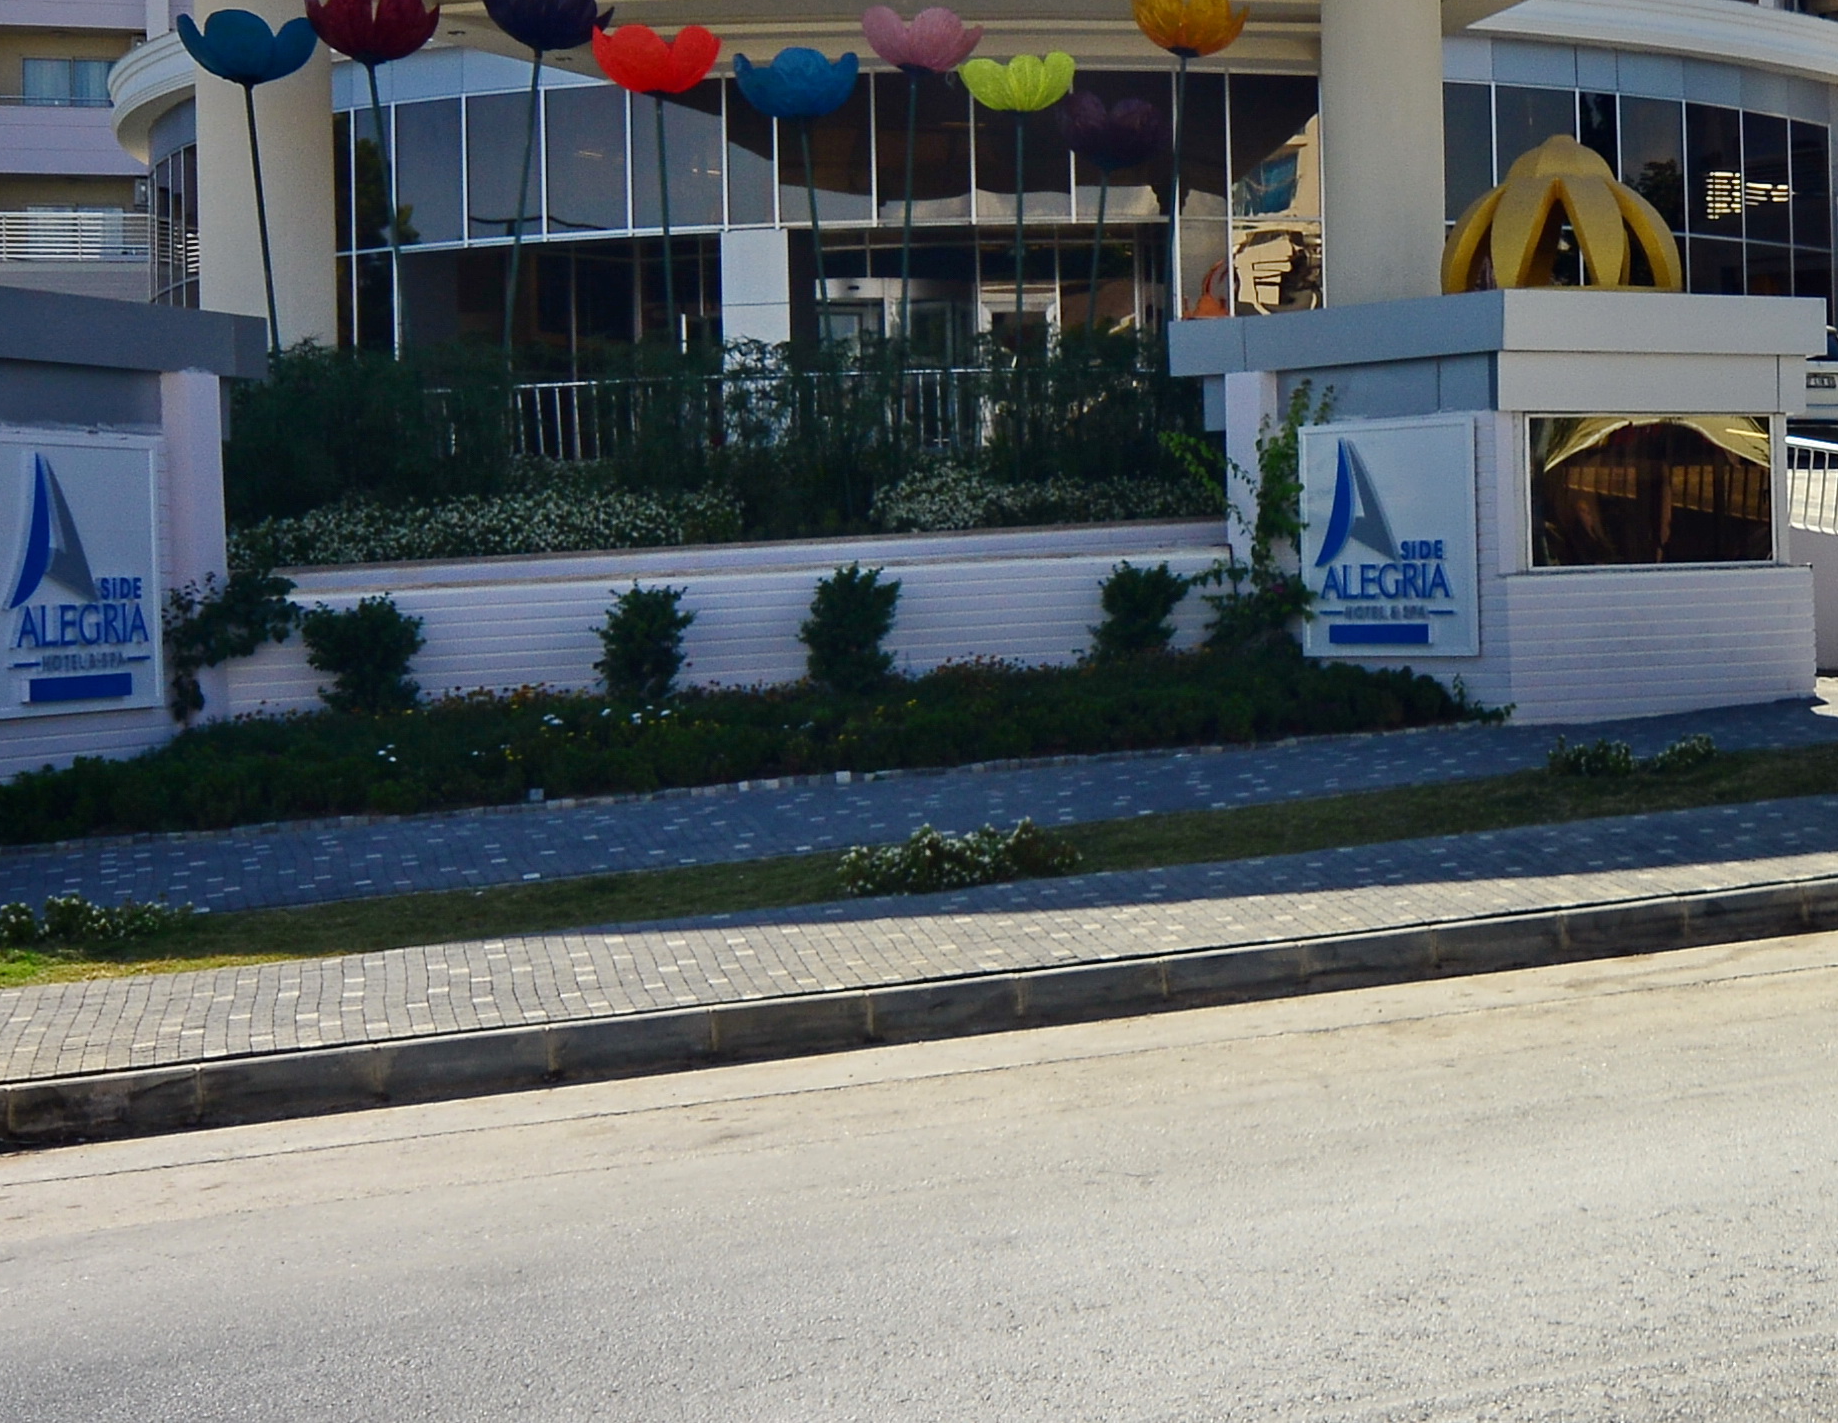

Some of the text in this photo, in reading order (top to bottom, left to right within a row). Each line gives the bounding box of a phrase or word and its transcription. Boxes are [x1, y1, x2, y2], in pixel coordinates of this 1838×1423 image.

[1321, 562, 1451, 599] ALEGRIA
[17, 602, 150, 648] ALEGRIA
[1345, 605, 1388, 620] HOTEL
[1403, 605, 1430, 620] SPA
[42, 653, 87, 672] HOTEL
[98, 651, 126, 668] SPA
